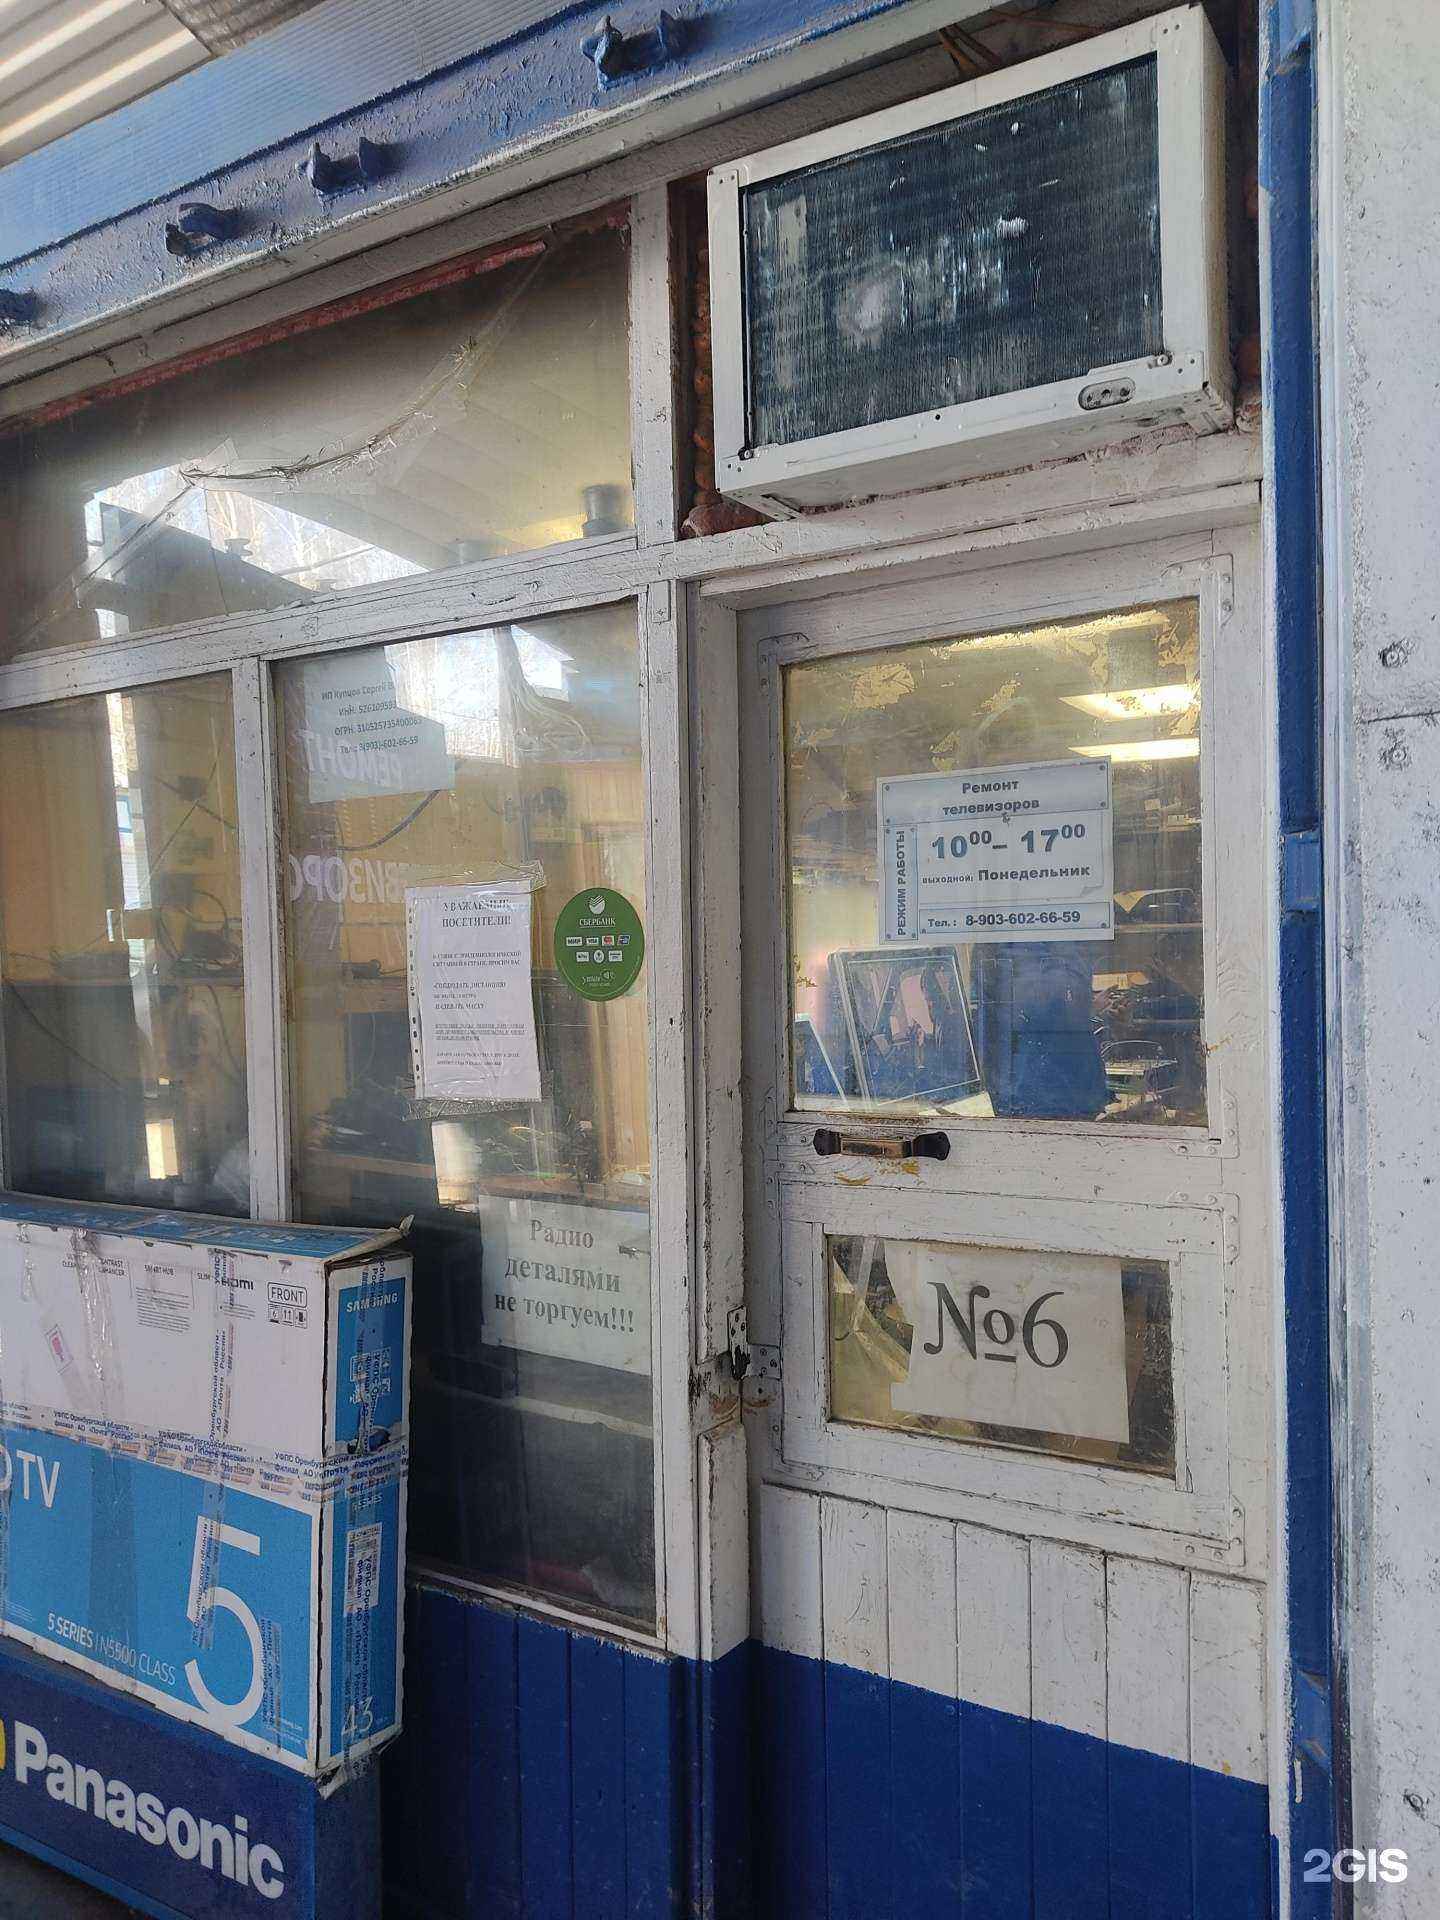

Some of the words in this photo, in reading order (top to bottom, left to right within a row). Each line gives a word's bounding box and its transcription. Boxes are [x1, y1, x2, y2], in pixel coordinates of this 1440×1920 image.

[961, 780, 1020, 794] Ремонт
[942, 799, 1040, 817] телевизоров
[896, 830, 905, 885] РАБОТЫ
[978, 865, 1090, 882] Понедельник
[579, 918, 616, 926] СБЕРБАНК
[897, 888, 906, 936] РЕЖИМ
[965, 910, 1081, 927] 8-903-602-66-59
[529, 1219, 594, 1249] Радио
[504, 1257, 621, 1293] деталями
[271, 1285, 305, 1304] FRONT
[495, 1293, 517, 1312] не
[523, 1297, 635, 1333] торгуем!!!
[16, 1449, 60, 1509] TV
[185, 1515, 263, 1727] 5
[47, 1612, 55, 1632] 5
[56, 1616, 95, 1649] SERIES
[138, 1652, 176, 1686] CLASS
[14, 1719, 286, 1900] Panasonic
